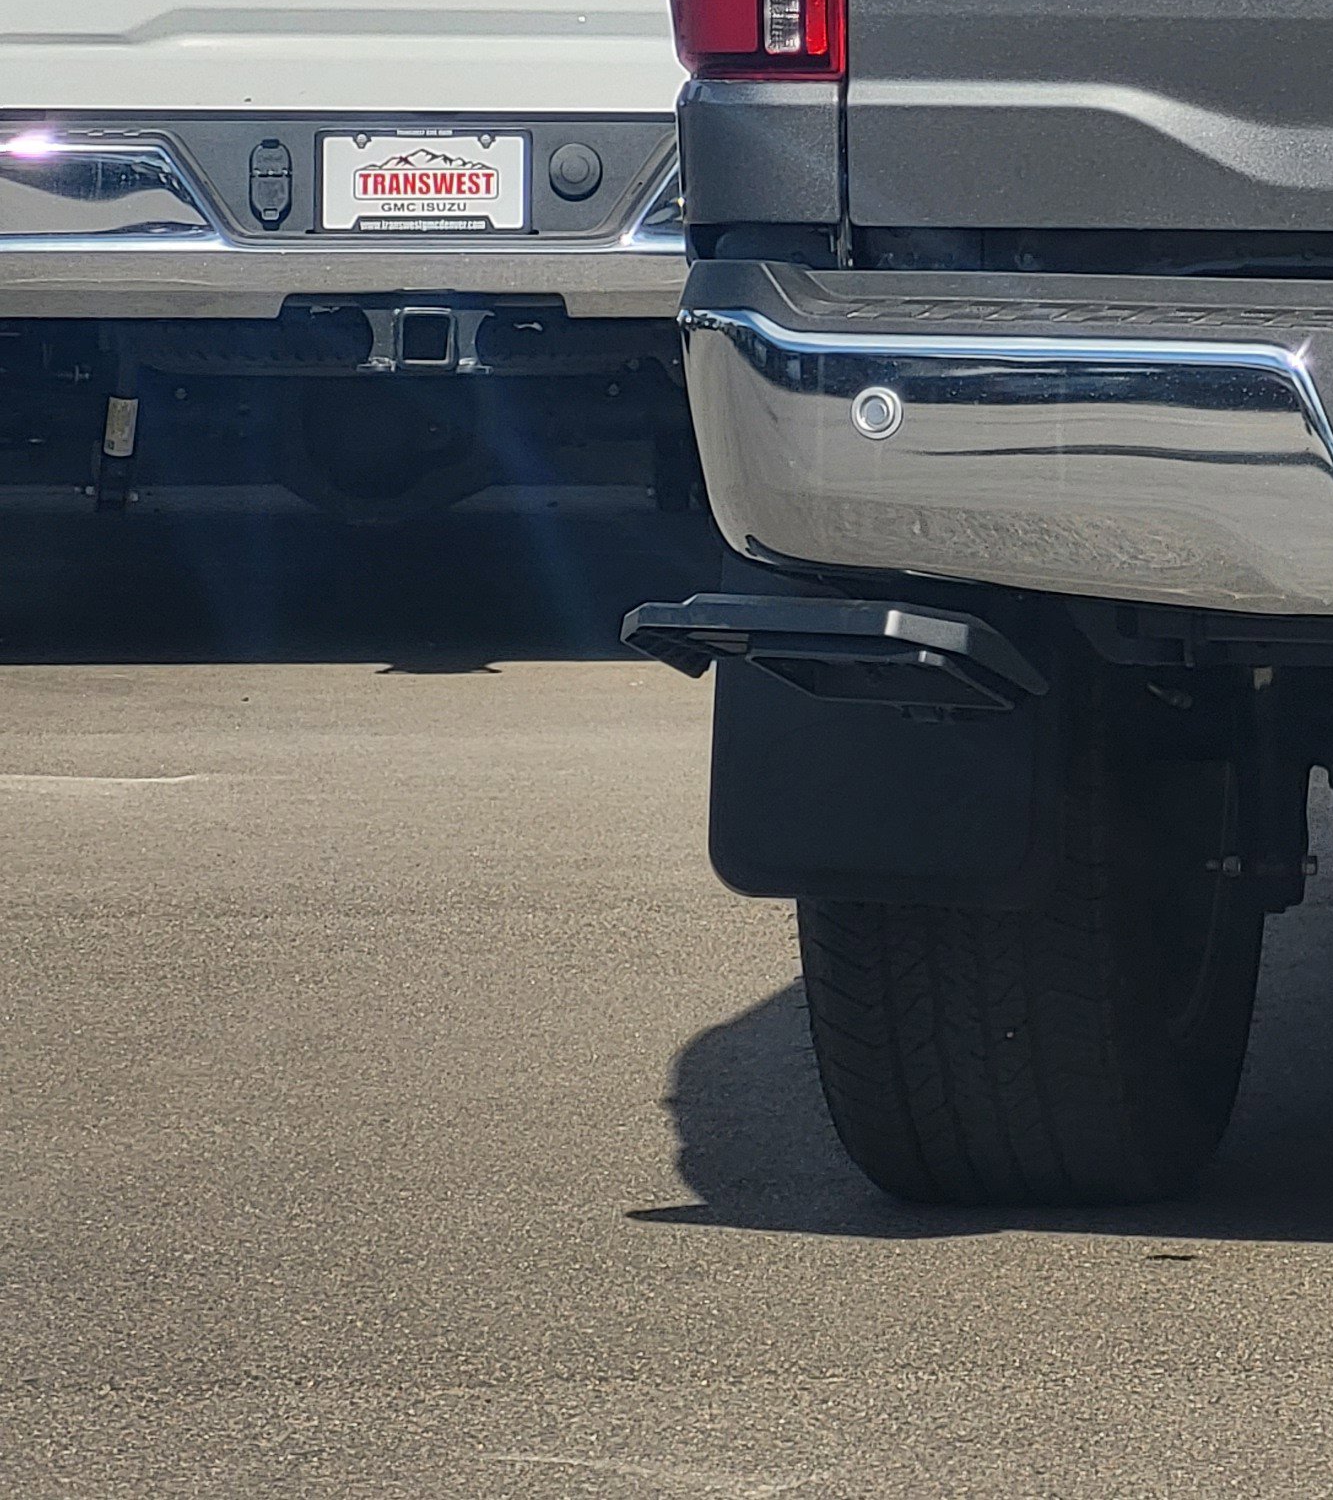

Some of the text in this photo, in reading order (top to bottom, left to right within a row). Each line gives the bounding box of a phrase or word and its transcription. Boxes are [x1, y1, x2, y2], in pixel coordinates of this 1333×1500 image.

[358, 172, 495, 196] TRANSWEST
[381, 202, 467, 213] GMC ISUZU
